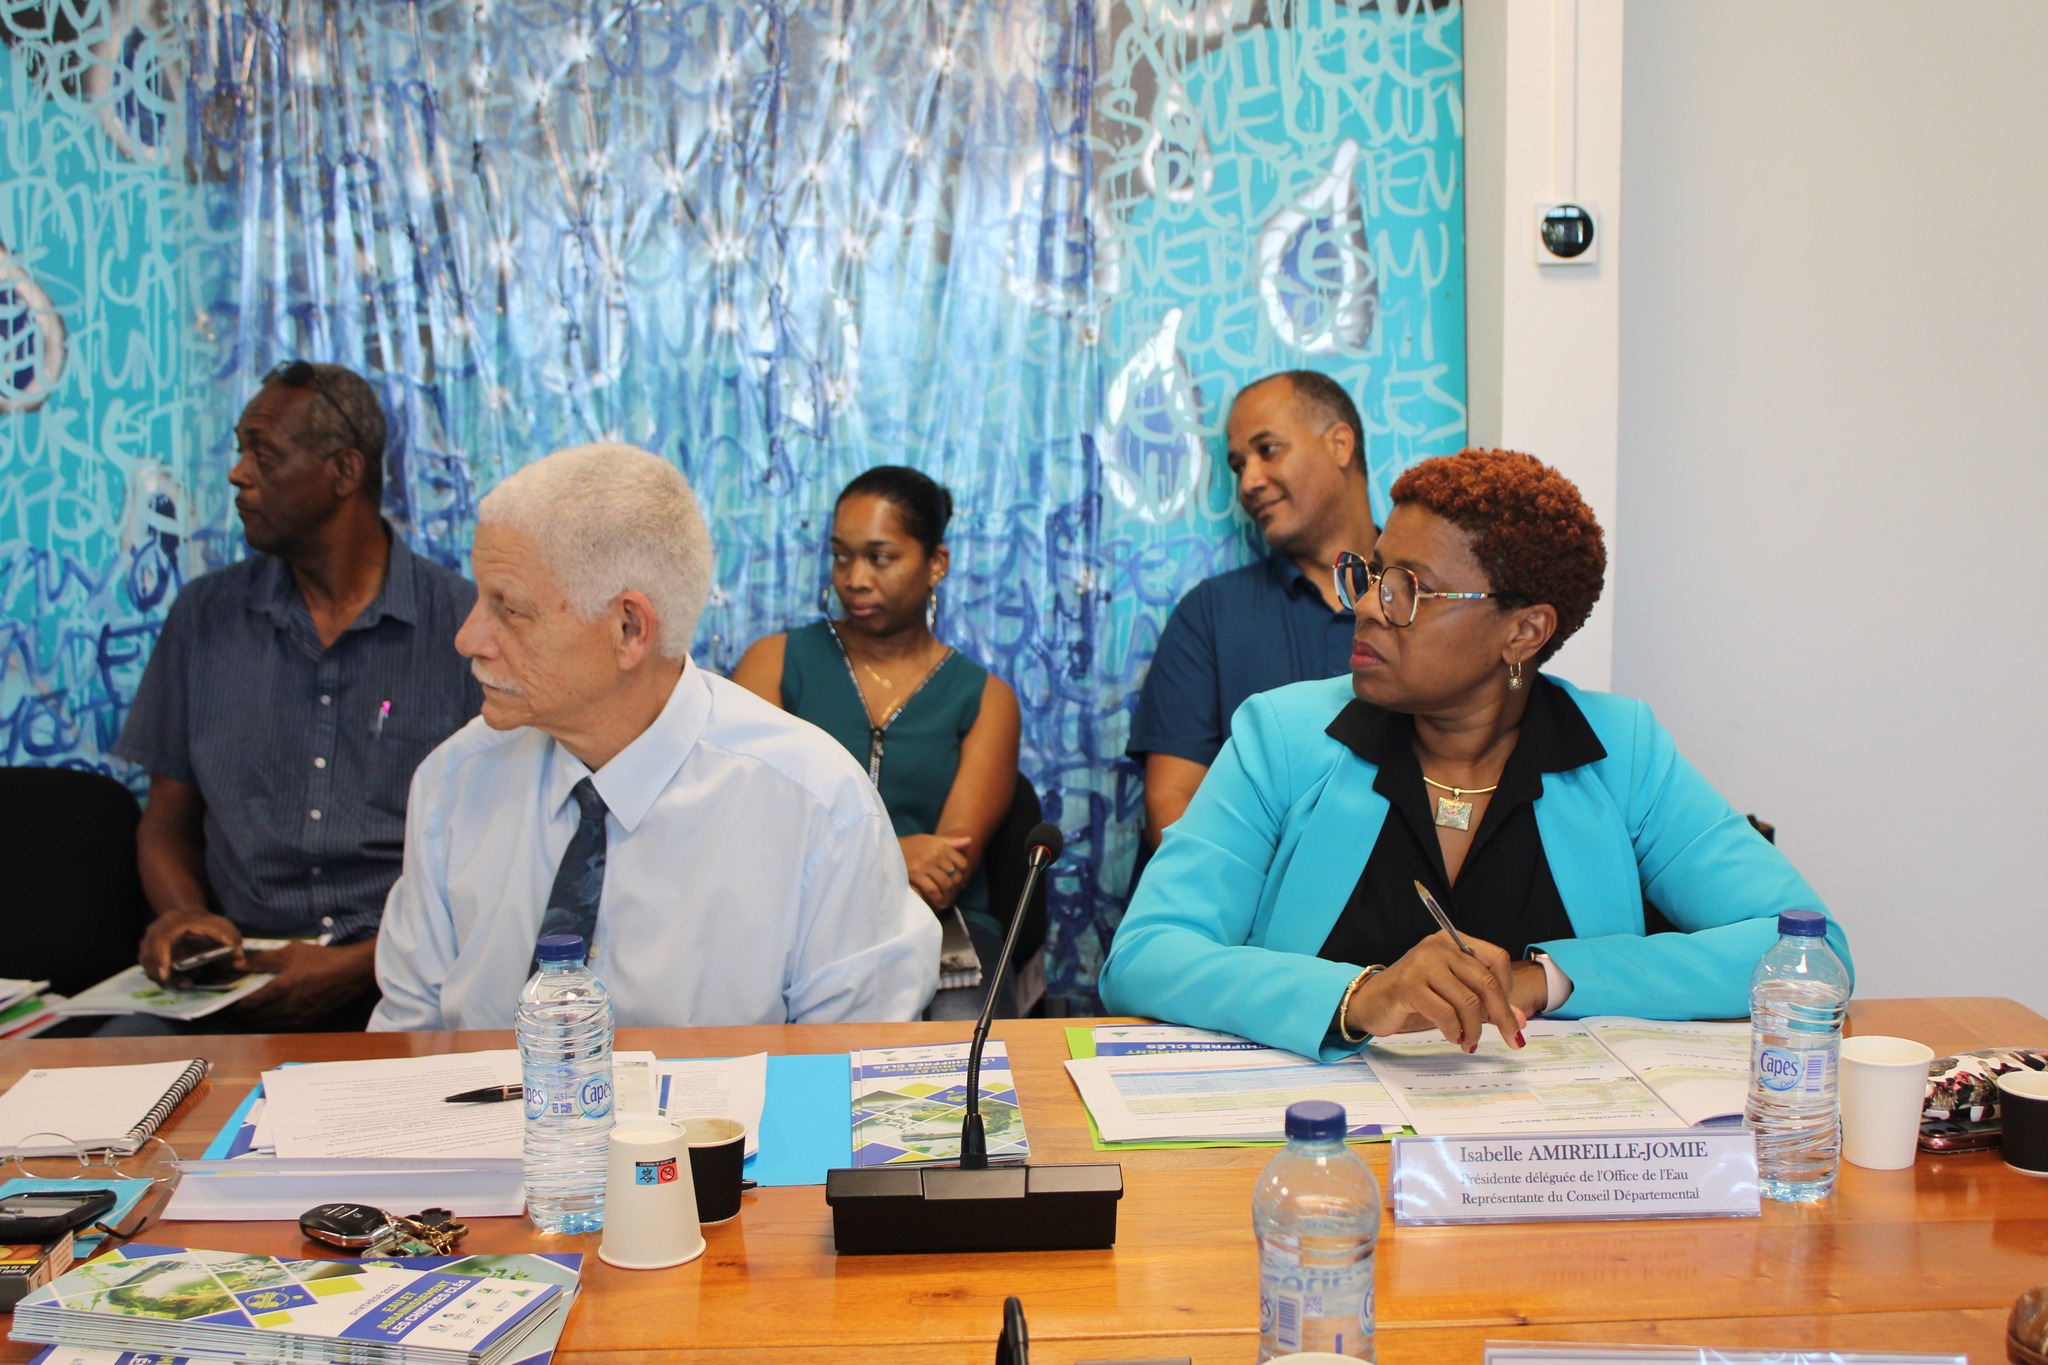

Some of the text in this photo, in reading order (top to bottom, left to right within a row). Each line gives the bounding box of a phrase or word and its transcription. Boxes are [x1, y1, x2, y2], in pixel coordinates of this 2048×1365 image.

[1460, 1141, 1708, 1162] Isabelle AMIREILLE-JOMIE
[1460, 1168, 1688, 1186] Présidente déléguée de l'Office de l'Eau
[1461, 1187, 1700, 1207] Représentante du Conseil Départemental
[387, 1321, 411, 1335] LES
